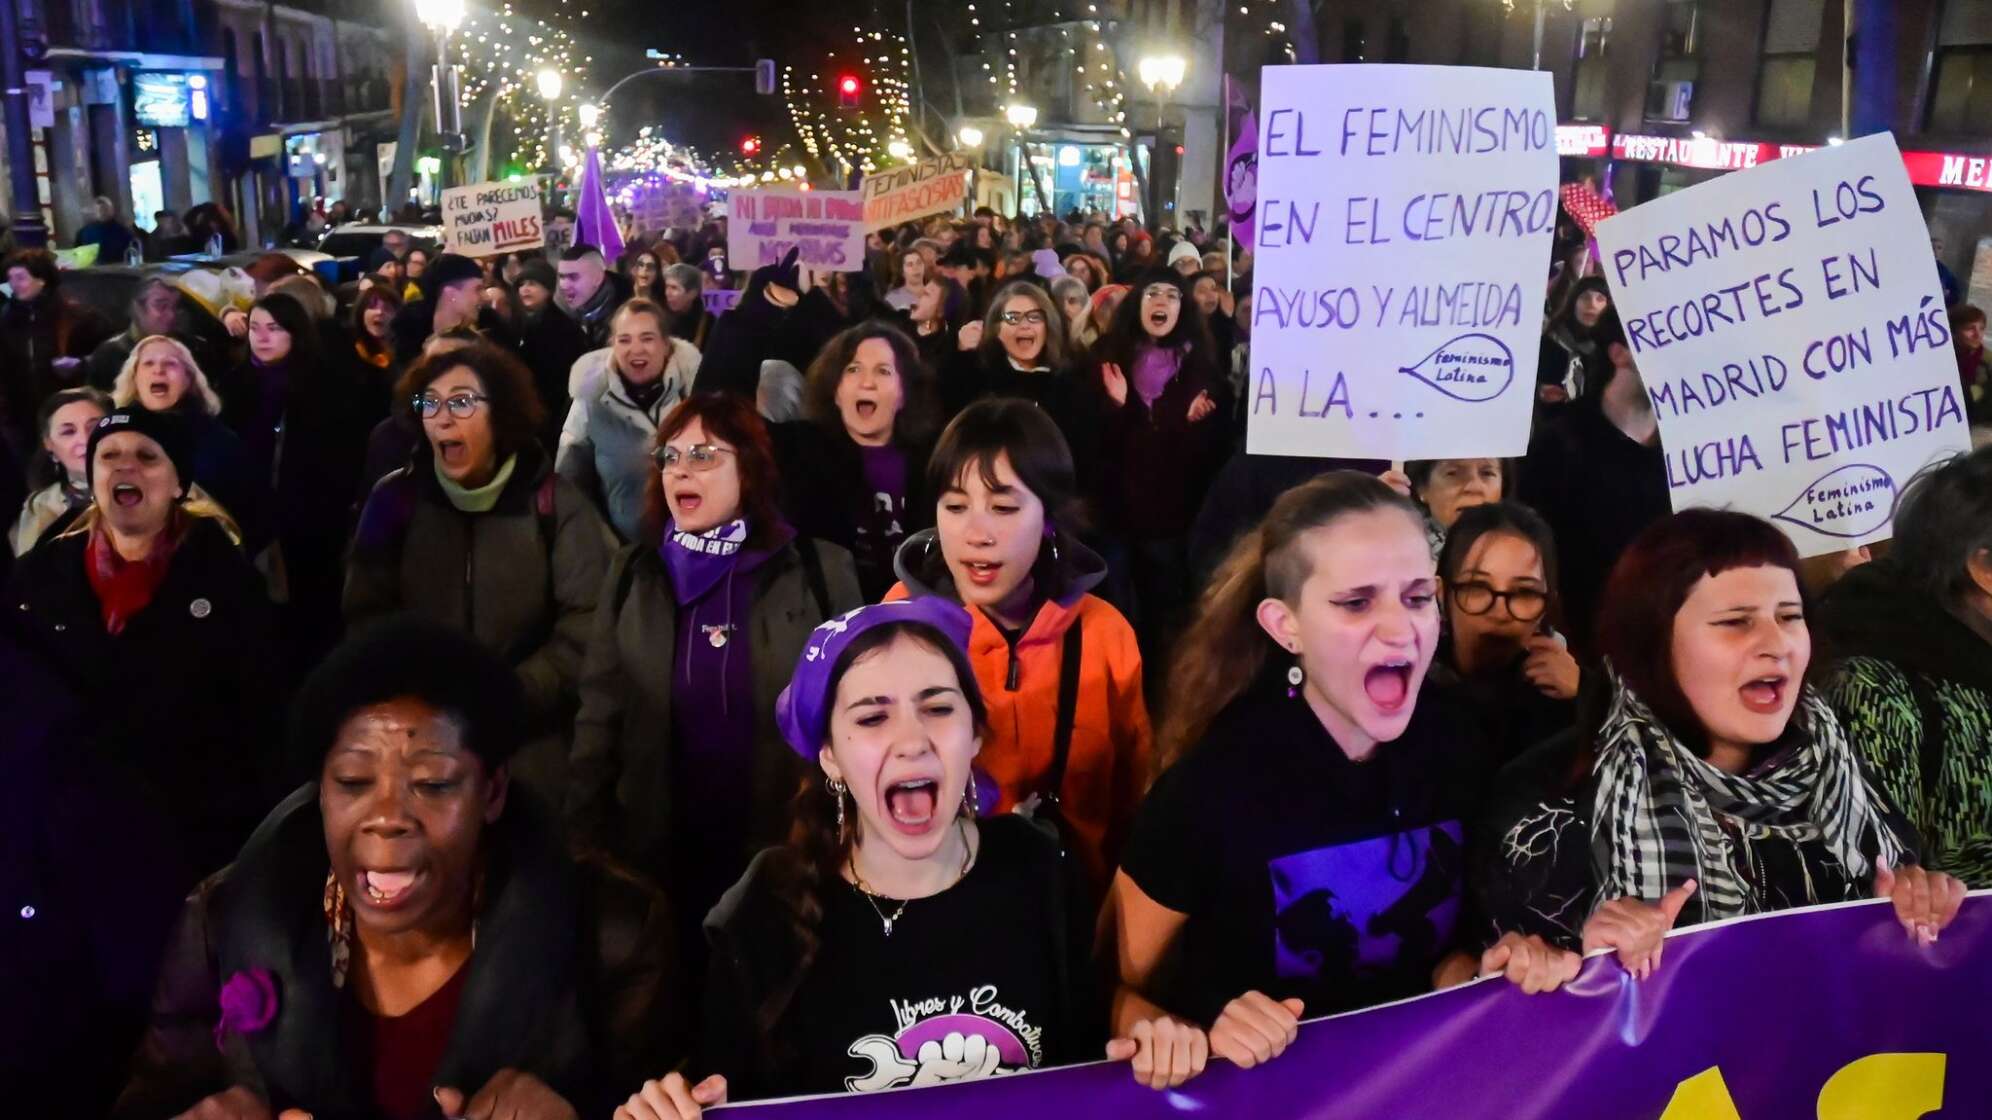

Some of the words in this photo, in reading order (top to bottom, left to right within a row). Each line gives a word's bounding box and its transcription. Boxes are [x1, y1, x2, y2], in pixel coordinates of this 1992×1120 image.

[1266, 108, 1321, 157] EL
[1340, 106, 1548, 157] FEMINISMO
[492, 215, 541, 243] MILES
[1259, 199, 1320, 248] EN
[1345, 196, 1391, 245] EL
[1613, 202, 1792, 288] PARAMOS
[1812, 174, 1886, 229] LOS
[1253, 285, 1361, 330] AYUSO
[1372, 284, 1395, 328] Y
[1398, 281, 1522, 330] ALMEIDA
[1626, 267, 1804, 354] RECORTES
[1820, 246, 1881, 301] EN
[1435, 366, 1488, 384] Latina
[1648, 354, 1788, 421] MADRID
[1802, 327, 1873, 381] CON
[1886, 294, 1951, 359] MÁS
[1253, 366, 1277, 416] A
[1665, 433, 1765, 490] LUCHA
[1781, 384, 1965, 465] FEMINISTA
[1812, 500, 1875, 524] Latina
[889, 997, 947, 1041] Libres
[949, 994, 965, 1017] y
